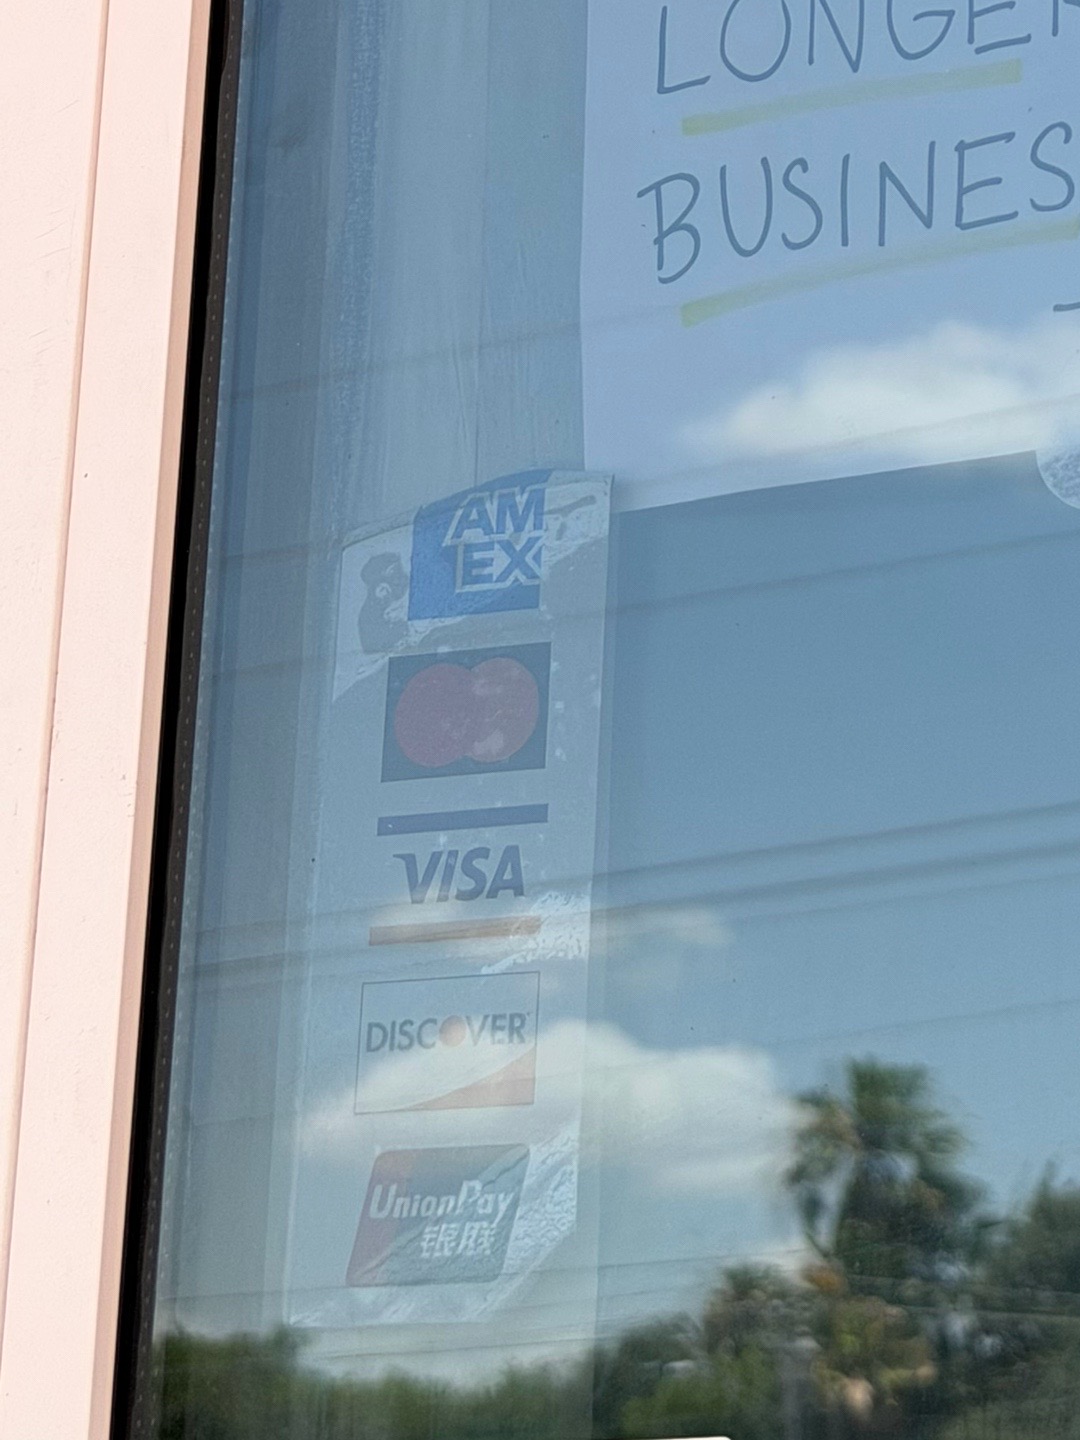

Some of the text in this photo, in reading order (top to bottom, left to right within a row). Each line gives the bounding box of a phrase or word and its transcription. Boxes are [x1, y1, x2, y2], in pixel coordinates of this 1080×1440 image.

[392, 844, 526, 905] VISA
[365, 1012, 527, 1054] DISCOVER
[368, 1179, 520, 1227] UnionPay
